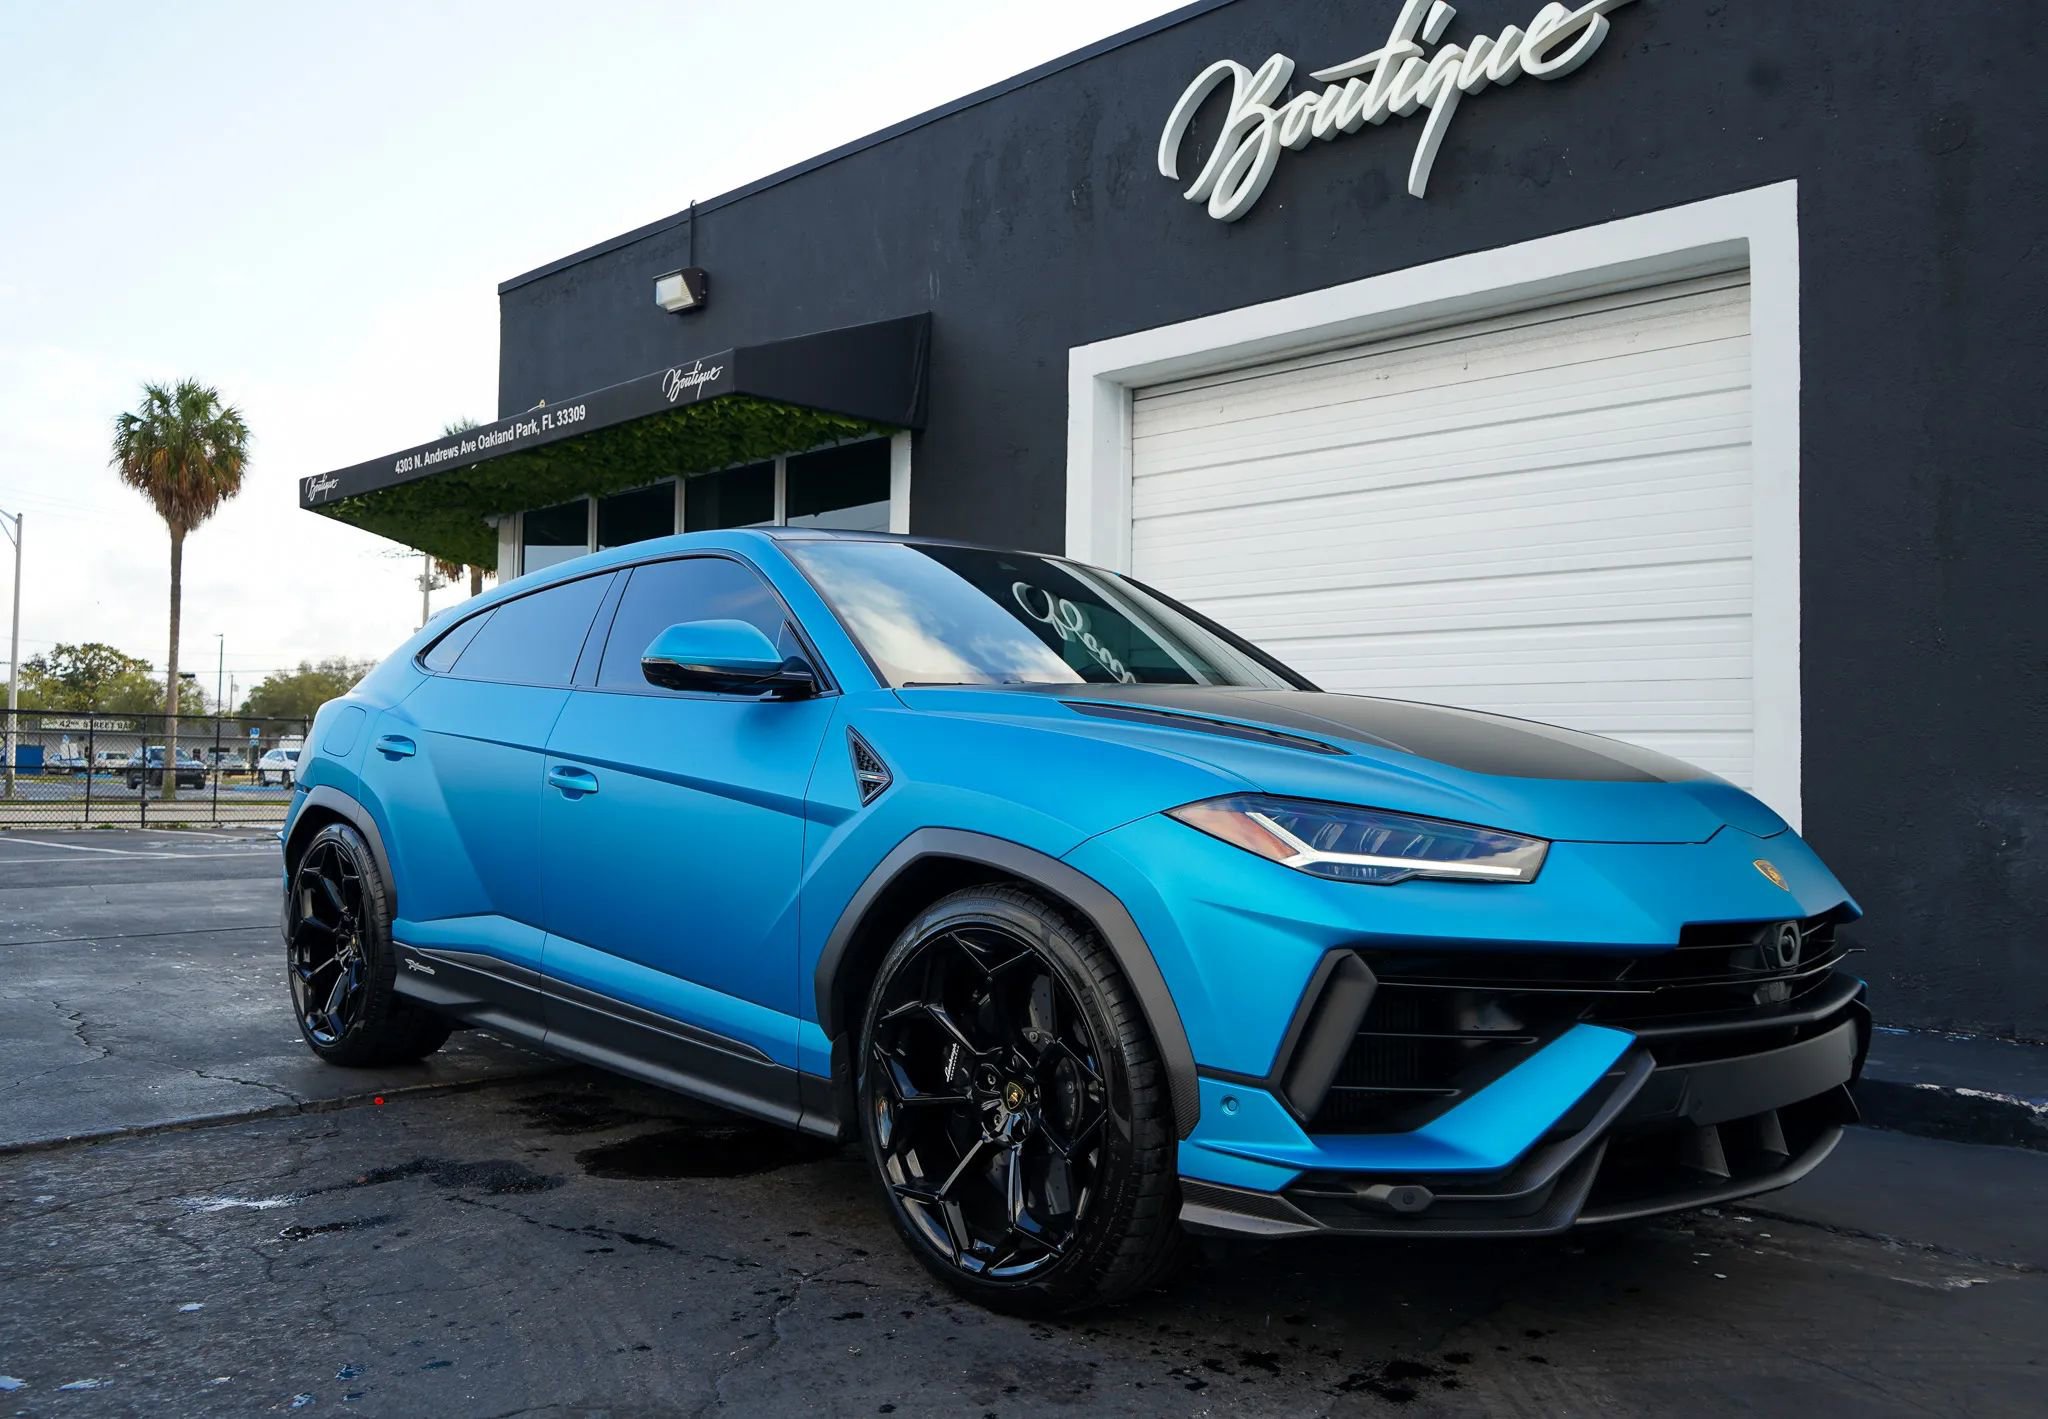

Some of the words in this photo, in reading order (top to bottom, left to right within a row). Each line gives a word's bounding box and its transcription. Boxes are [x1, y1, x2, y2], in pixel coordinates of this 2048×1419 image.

[1158, 0, 1640, 222] Boutique
[662, 360, 724, 403] Boutique
[395, 458, 413, 475] 4303
[414, 455, 423, 469] N.
[424, 444, 459, 465] Andrews
[460, 440, 477, 456] Ave
[478, 428, 514, 450] Oakland
[516, 419, 541, 439] Park,
[542, 413, 555, 431] FL
[556, 404, 586, 427] 33309
[305, 473, 340, 502] Boutique
